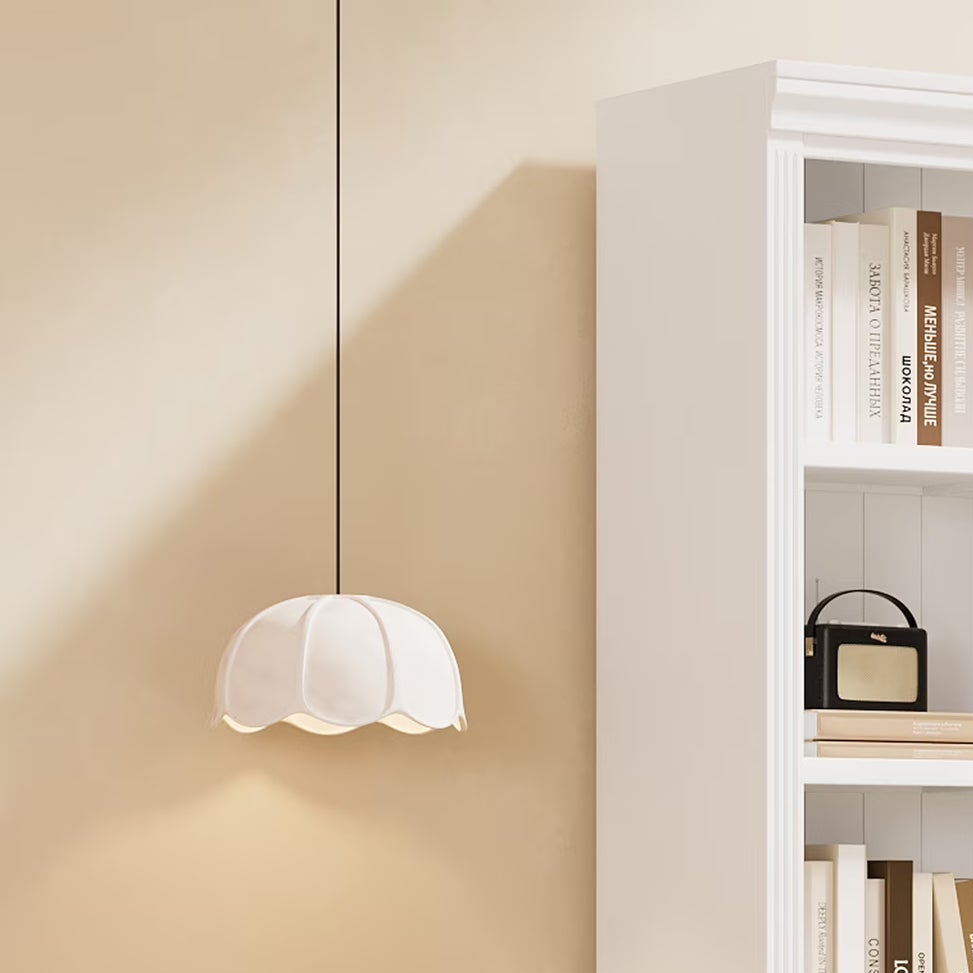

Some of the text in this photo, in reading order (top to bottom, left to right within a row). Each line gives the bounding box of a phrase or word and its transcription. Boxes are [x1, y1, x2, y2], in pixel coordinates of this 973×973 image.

[868, 263, 881, 419] ЗАБОТА О ПРЕДАННЫХ
[900, 355, 912, 423] ШОКОЛАД
[923, 381, 937, 426] ЛУЧШЕ
